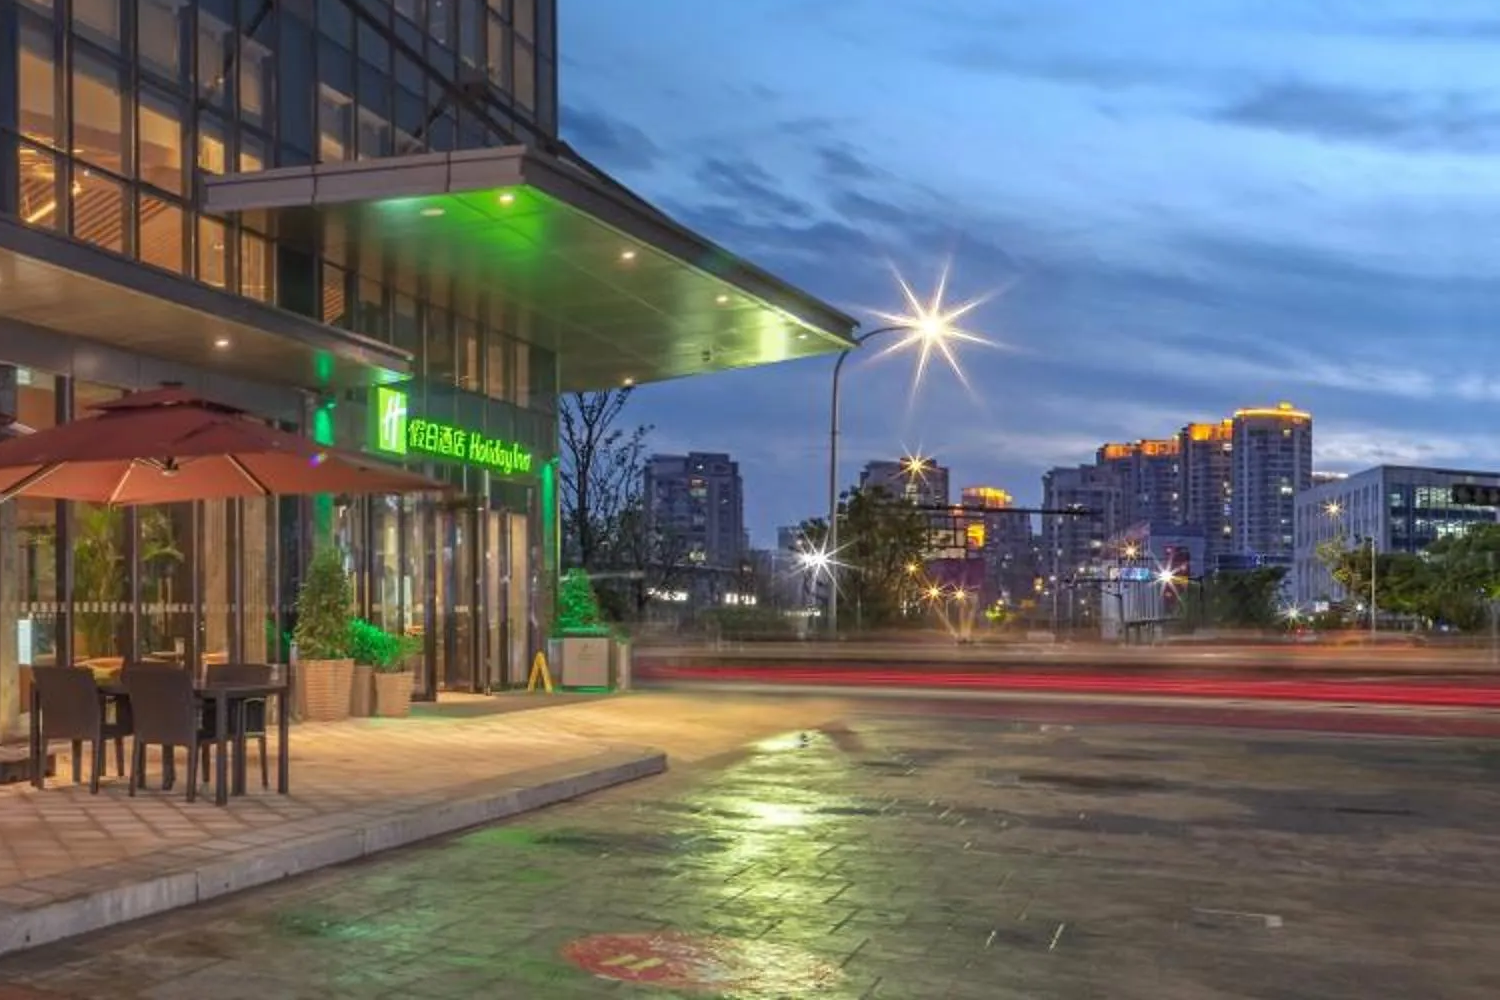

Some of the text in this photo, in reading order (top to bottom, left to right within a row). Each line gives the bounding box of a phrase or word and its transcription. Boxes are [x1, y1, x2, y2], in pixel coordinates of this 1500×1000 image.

[408, 419, 531, 474] 假日酒店 Holiday Inn
